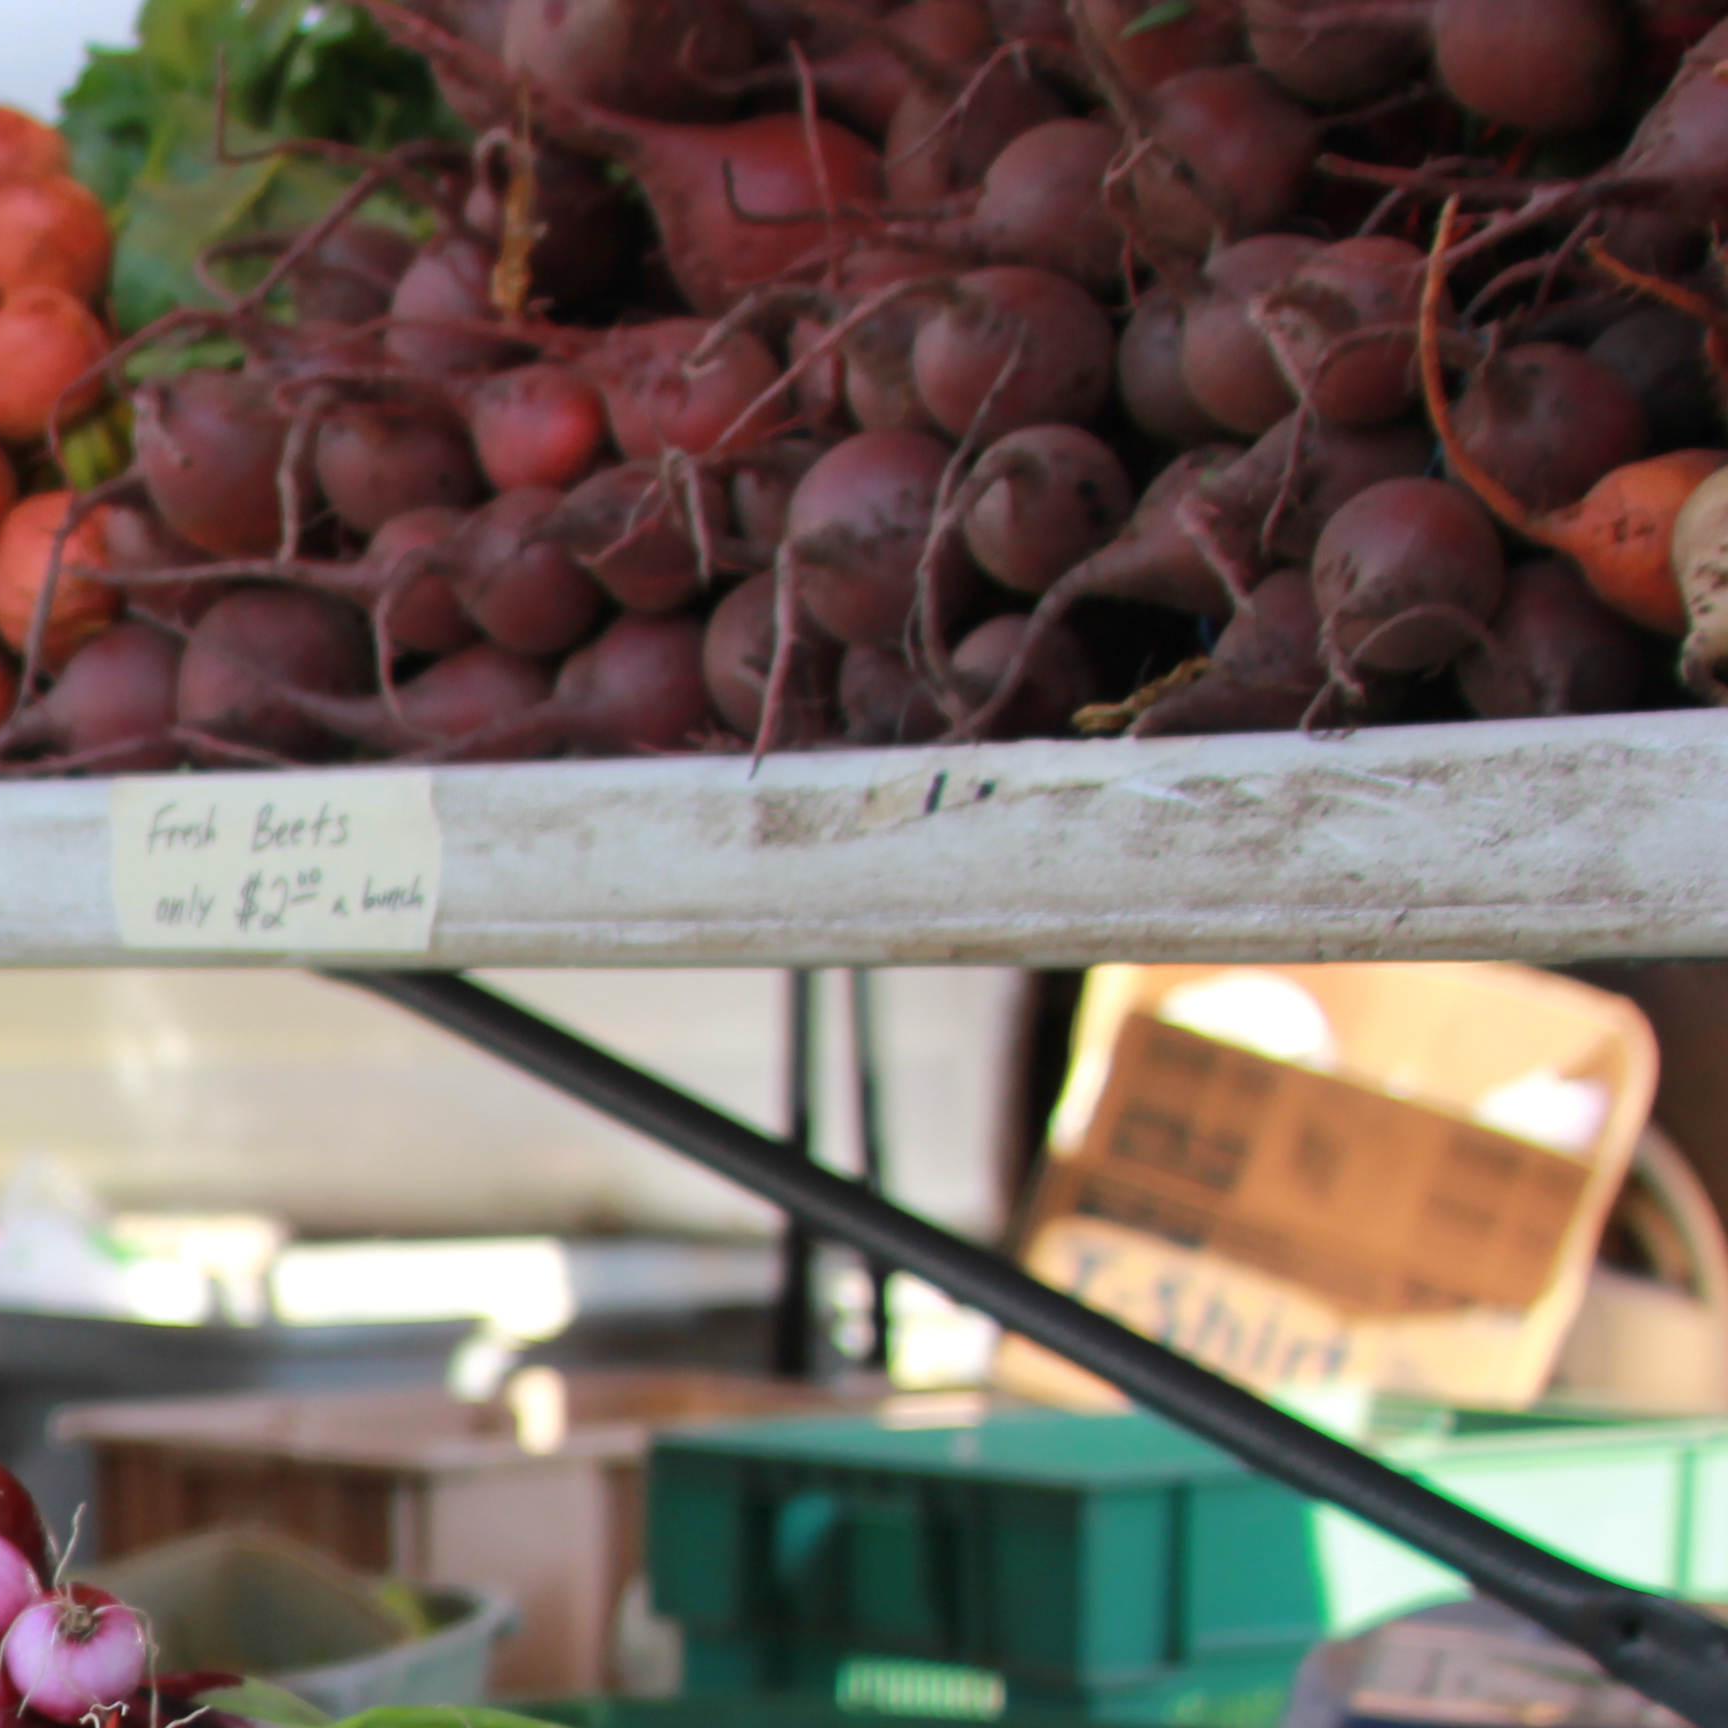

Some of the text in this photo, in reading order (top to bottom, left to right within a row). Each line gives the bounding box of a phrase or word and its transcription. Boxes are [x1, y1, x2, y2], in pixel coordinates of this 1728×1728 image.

[146, 802, 350, 853] Fresh Beets
[155, 883, 215, 929] only
[331, 896, 349, 916] a
[362, 873, 425, 912] bunch
